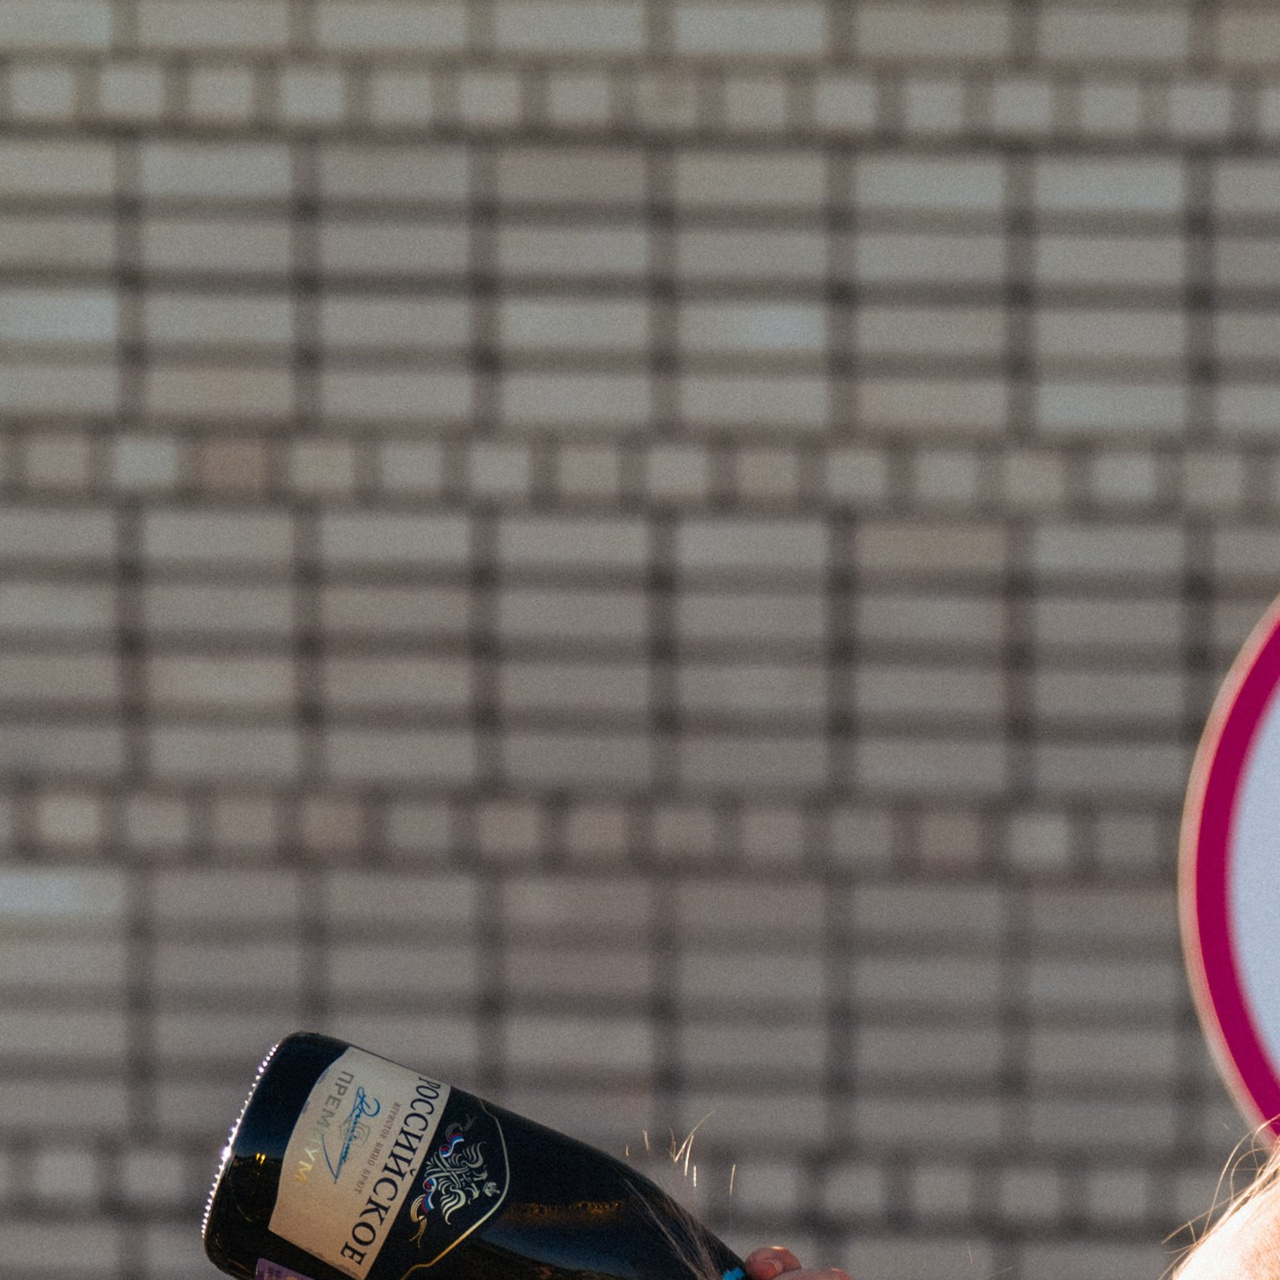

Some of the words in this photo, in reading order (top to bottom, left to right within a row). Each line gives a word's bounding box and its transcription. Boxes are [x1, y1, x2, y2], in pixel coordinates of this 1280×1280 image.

[369, 1141, 385, 1168] ВИНО
[341, 1076, 442, 1266] РОССИЙСКОЕ
[354, 1167, 372, 1195] БРЮТ
